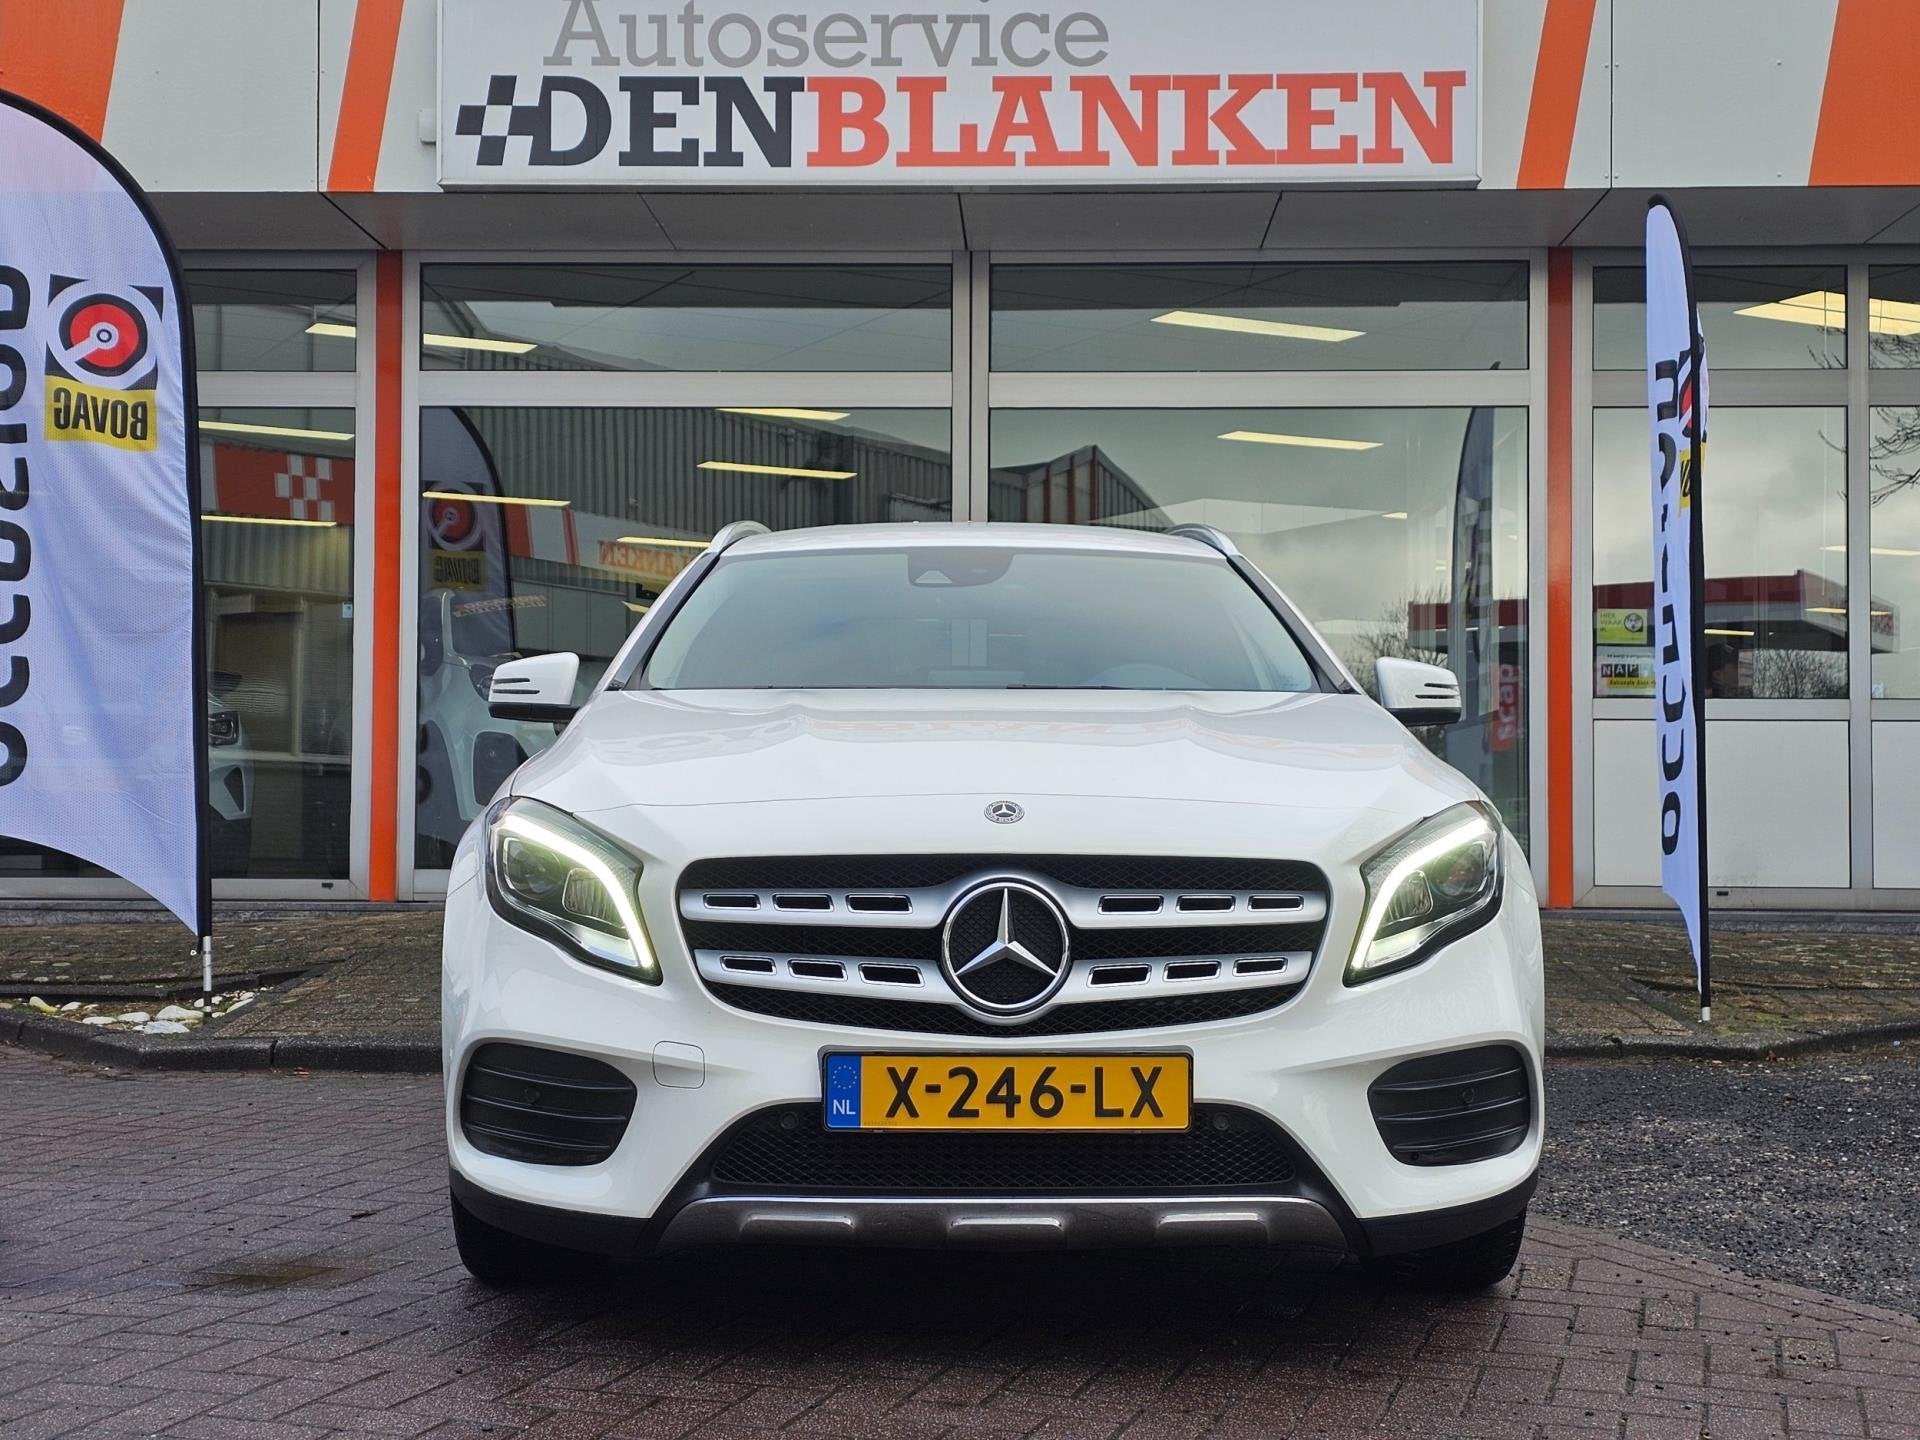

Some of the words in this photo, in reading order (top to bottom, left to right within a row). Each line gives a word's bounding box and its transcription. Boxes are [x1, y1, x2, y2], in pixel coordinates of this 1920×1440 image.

[543, 0, 1109, 67] Autoservice
[833, 1099, 856, 1115] NL
[886, 1066, 1164, 1118] X-246-LX
